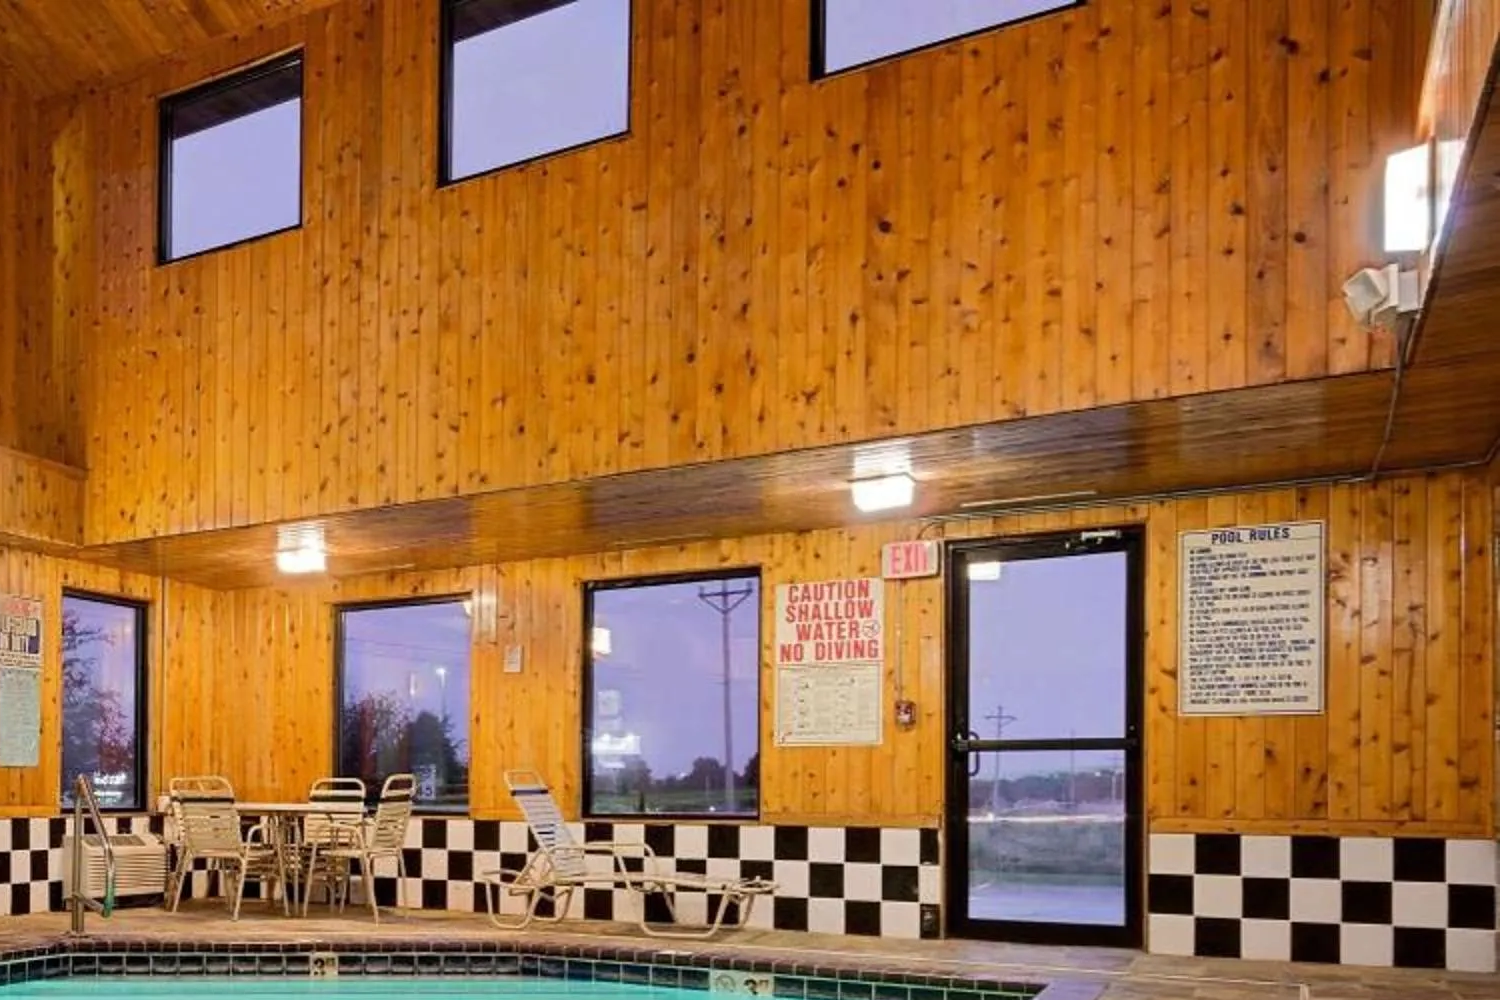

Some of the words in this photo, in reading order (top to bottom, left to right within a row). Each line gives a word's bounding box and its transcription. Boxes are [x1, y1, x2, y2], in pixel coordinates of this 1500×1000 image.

[1211, 531, 1243, 545] POOL
[1249, 527, 1291, 542] RULES
[891, 544, 927, 574] EXIT
[788, 580, 870, 603] CAUTION
[785, 599, 875, 623] SHALLOW
[795, 619, 861, 642] WATER
[779, 643, 804, 663] NO
[814, 639, 879, 661] DIVING
